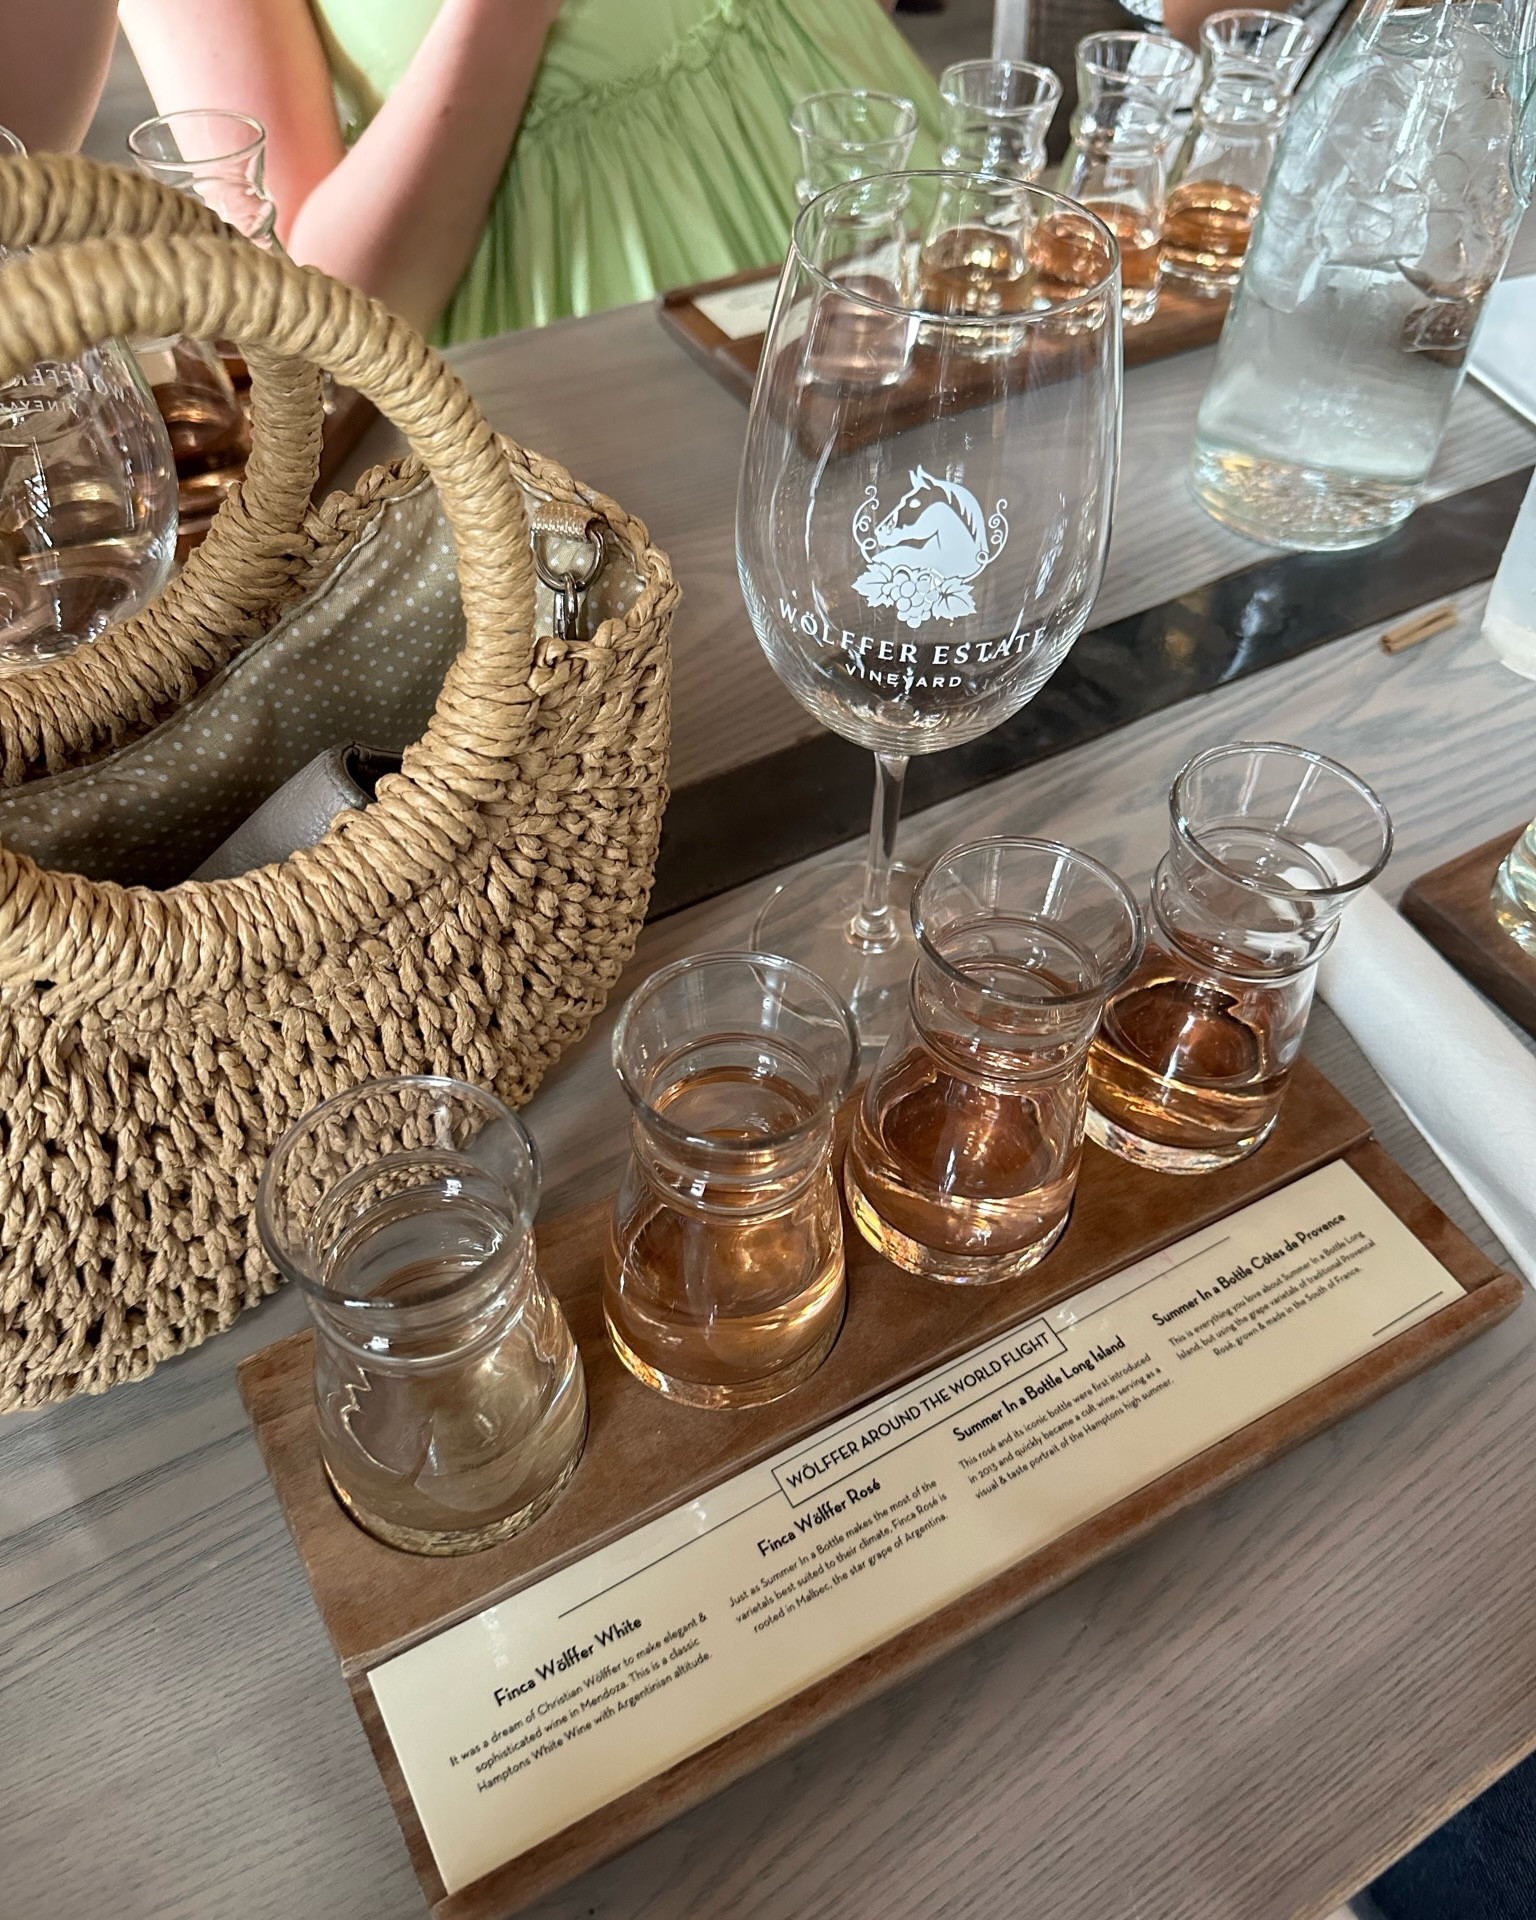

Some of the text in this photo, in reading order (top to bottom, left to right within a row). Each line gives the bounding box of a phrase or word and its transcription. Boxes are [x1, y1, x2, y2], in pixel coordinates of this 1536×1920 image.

[779, 598, 1047, 665] WÖLFFER ESTATE
[845, 664, 962, 689] VINEYARD
[1152, 1298, 1199, 1326] Summer
[1196, 1290, 1213, 1301] In
[1216, 1266, 1254, 1289] Bottle
[1251, 1250, 1286, 1269] Côtes
[1284, 1240, 1300, 1251] de
[1295, 1215, 1346, 1244] Provence
[1168, 1335, 1187, 1346] This
[1194, 1309, 1234, 1333] everything
[1232, 1301, 1247, 1312] you
[1243, 1291, 1263, 1303] love
[1262, 1278, 1284, 1293] about
[1281, 1262, 1311, 1281] Summer
[1323, 1242, 1347, 1256] Bottle
[1344, 1232, 1366, 1244] Long
[1200, 1335, 1217, 1346] but
[1216, 1324, 1238, 1338] using
[1234, 1317, 1249, 1326] the
[1249, 1304, 1270, 1320] grape
[1270, 1286, 1300, 1305] varietals
[1299, 1279, 1308, 1288] of
[1306, 1258, 1343, 1283] traditional
[1236, 1328, 1260, 1346] grown
[1257, 1322, 1267, 1330] &
[1266, 1312, 1287, 1326] made
[1292, 1300, 1307, 1309] the
[1305, 1286, 1328, 1301] South
[1328, 1279, 1336, 1289] of
[786, 1332, 1049, 1488] WÖLFFER AROUND THE WORLD FLIGHT
[953, 1335, 1126, 1441] Summer In a Bottle Long Island
[958, 1353, 1152, 1469] This rosé and its iconic bottle were first introduced
[968, 1476, 979, 1484] in
[978, 1463, 999, 1478] 2013
[999, 1451, 1015, 1466] and
[1015, 1436, 1043, 1456] quickly
[1041, 1419, 1075, 1439] became
[1081, 1404, 1097, 1417] cult
[1097, 1395, 1119, 1407] wine,
[1118, 1377, 1148, 1395] serving
[1146, 1371, 1156, 1379] as
[976, 1379, 1175, 1499] visual & taste portrait of the Hamptons high summer.
[730, 1591, 750, 1607] Just
[751, 1585, 761, 1595] as
[761, 1562, 798, 1588] Summer
[798, 1557, 810, 1565] In
[816, 1535, 845, 1555] Bottle
[846, 1519, 874, 1538] makes
[873, 1510, 889, 1521] the
[890, 1495, 912, 1512] most
[912, 1486, 922, 1498] of
[921, 1481, 937, 1492] the
[736, 1596, 775, 1622] varietals
[774, 1583, 797, 1600] best
[797, 1564, 825, 1587] suited
[825, 1560, 836, 1569] to
[836, 1547, 857, 1563] their
[859, 1528, 893, 1549] climate,
[892, 1512, 917, 1529] Finca
[916, 1497, 939, 1515] Rosé
[754, 1515, 950, 1632] rooted in Malbec, the star grape of Argentina.
[757, 1478, 881, 1556] Finca Wölffer Rosé
[450, 1612, 708, 1767] It was a dream of Christian Wölffer to make elegant &
[476, 1727, 543, 1773] sophisticated
[544, 1716, 569, 1732] wine
[570, 1709, 580, 1718] in
[580, 1682, 630, 1711] Mendoza.
[628, 1668, 651, 1682] This
[651, 1662, 661, 1670] is
[670, 1639, 701, 1660] classic
[494, 1619, 642, 1706] Finca Wölffer White
[477, 1653, 713, 1793] Hamptons White Wine with Argentinian altitude.
